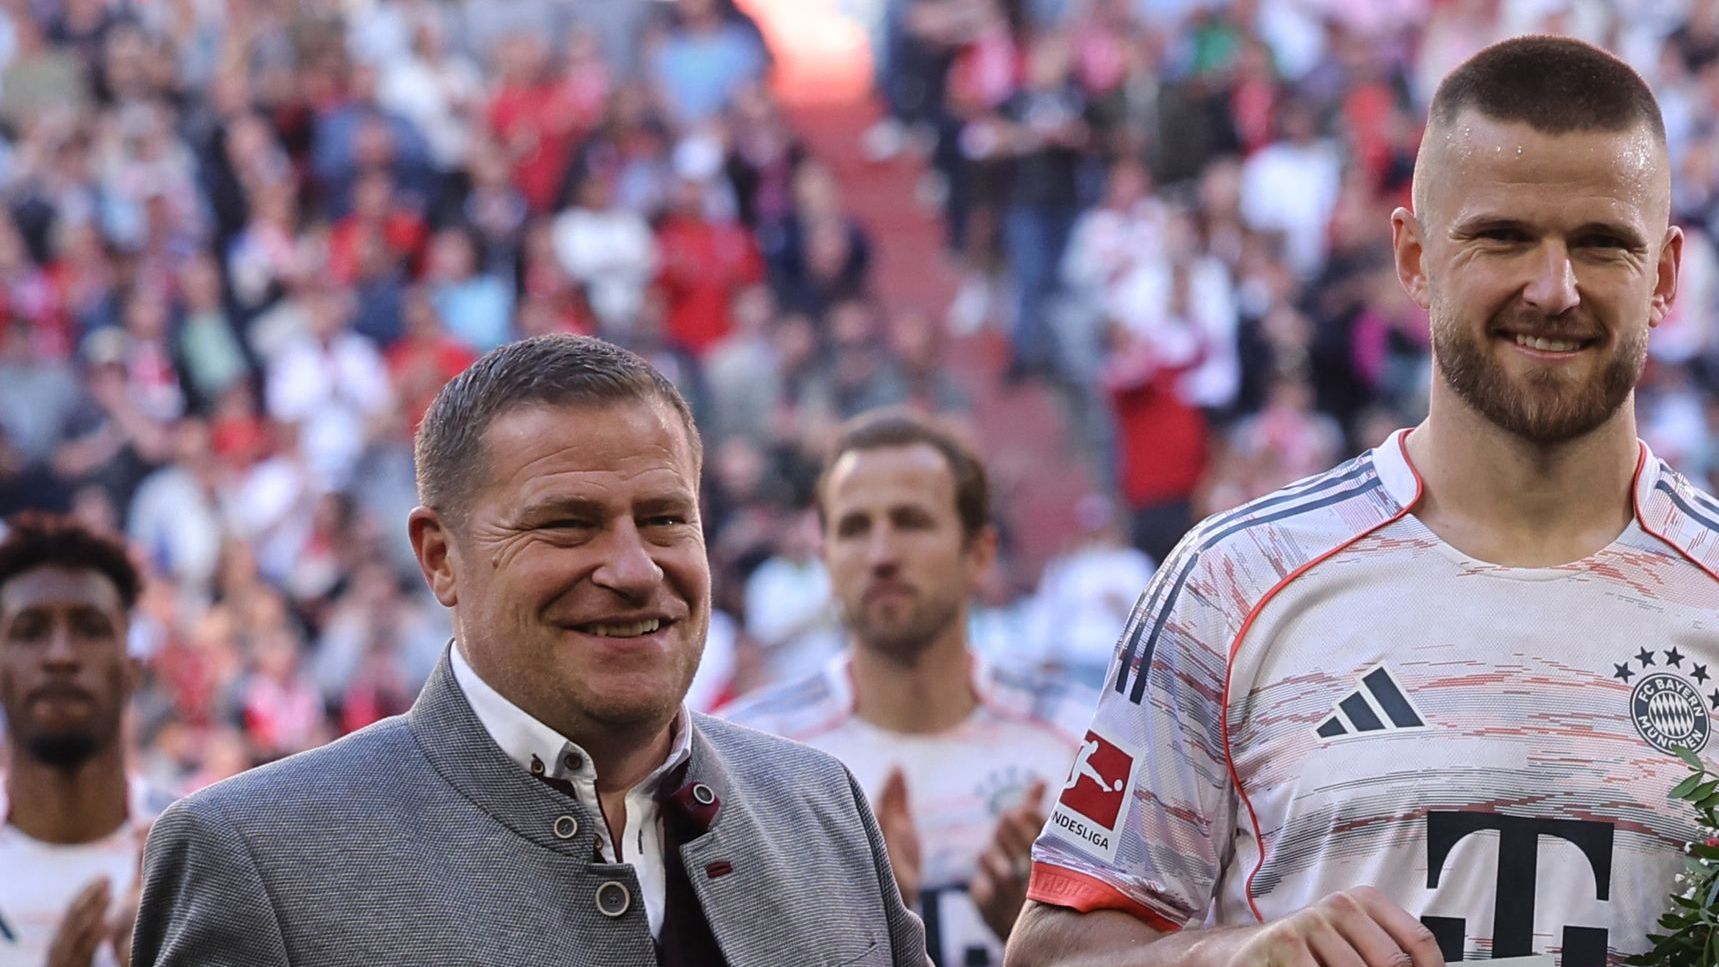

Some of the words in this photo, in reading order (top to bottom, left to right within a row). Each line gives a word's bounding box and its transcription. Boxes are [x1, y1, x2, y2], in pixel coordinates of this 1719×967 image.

[1638, 684, 1655, 703] FC
[1655, 678, 1705, 718] BAYERN
[1051, 810, 1110, 851] NDESLIGA
